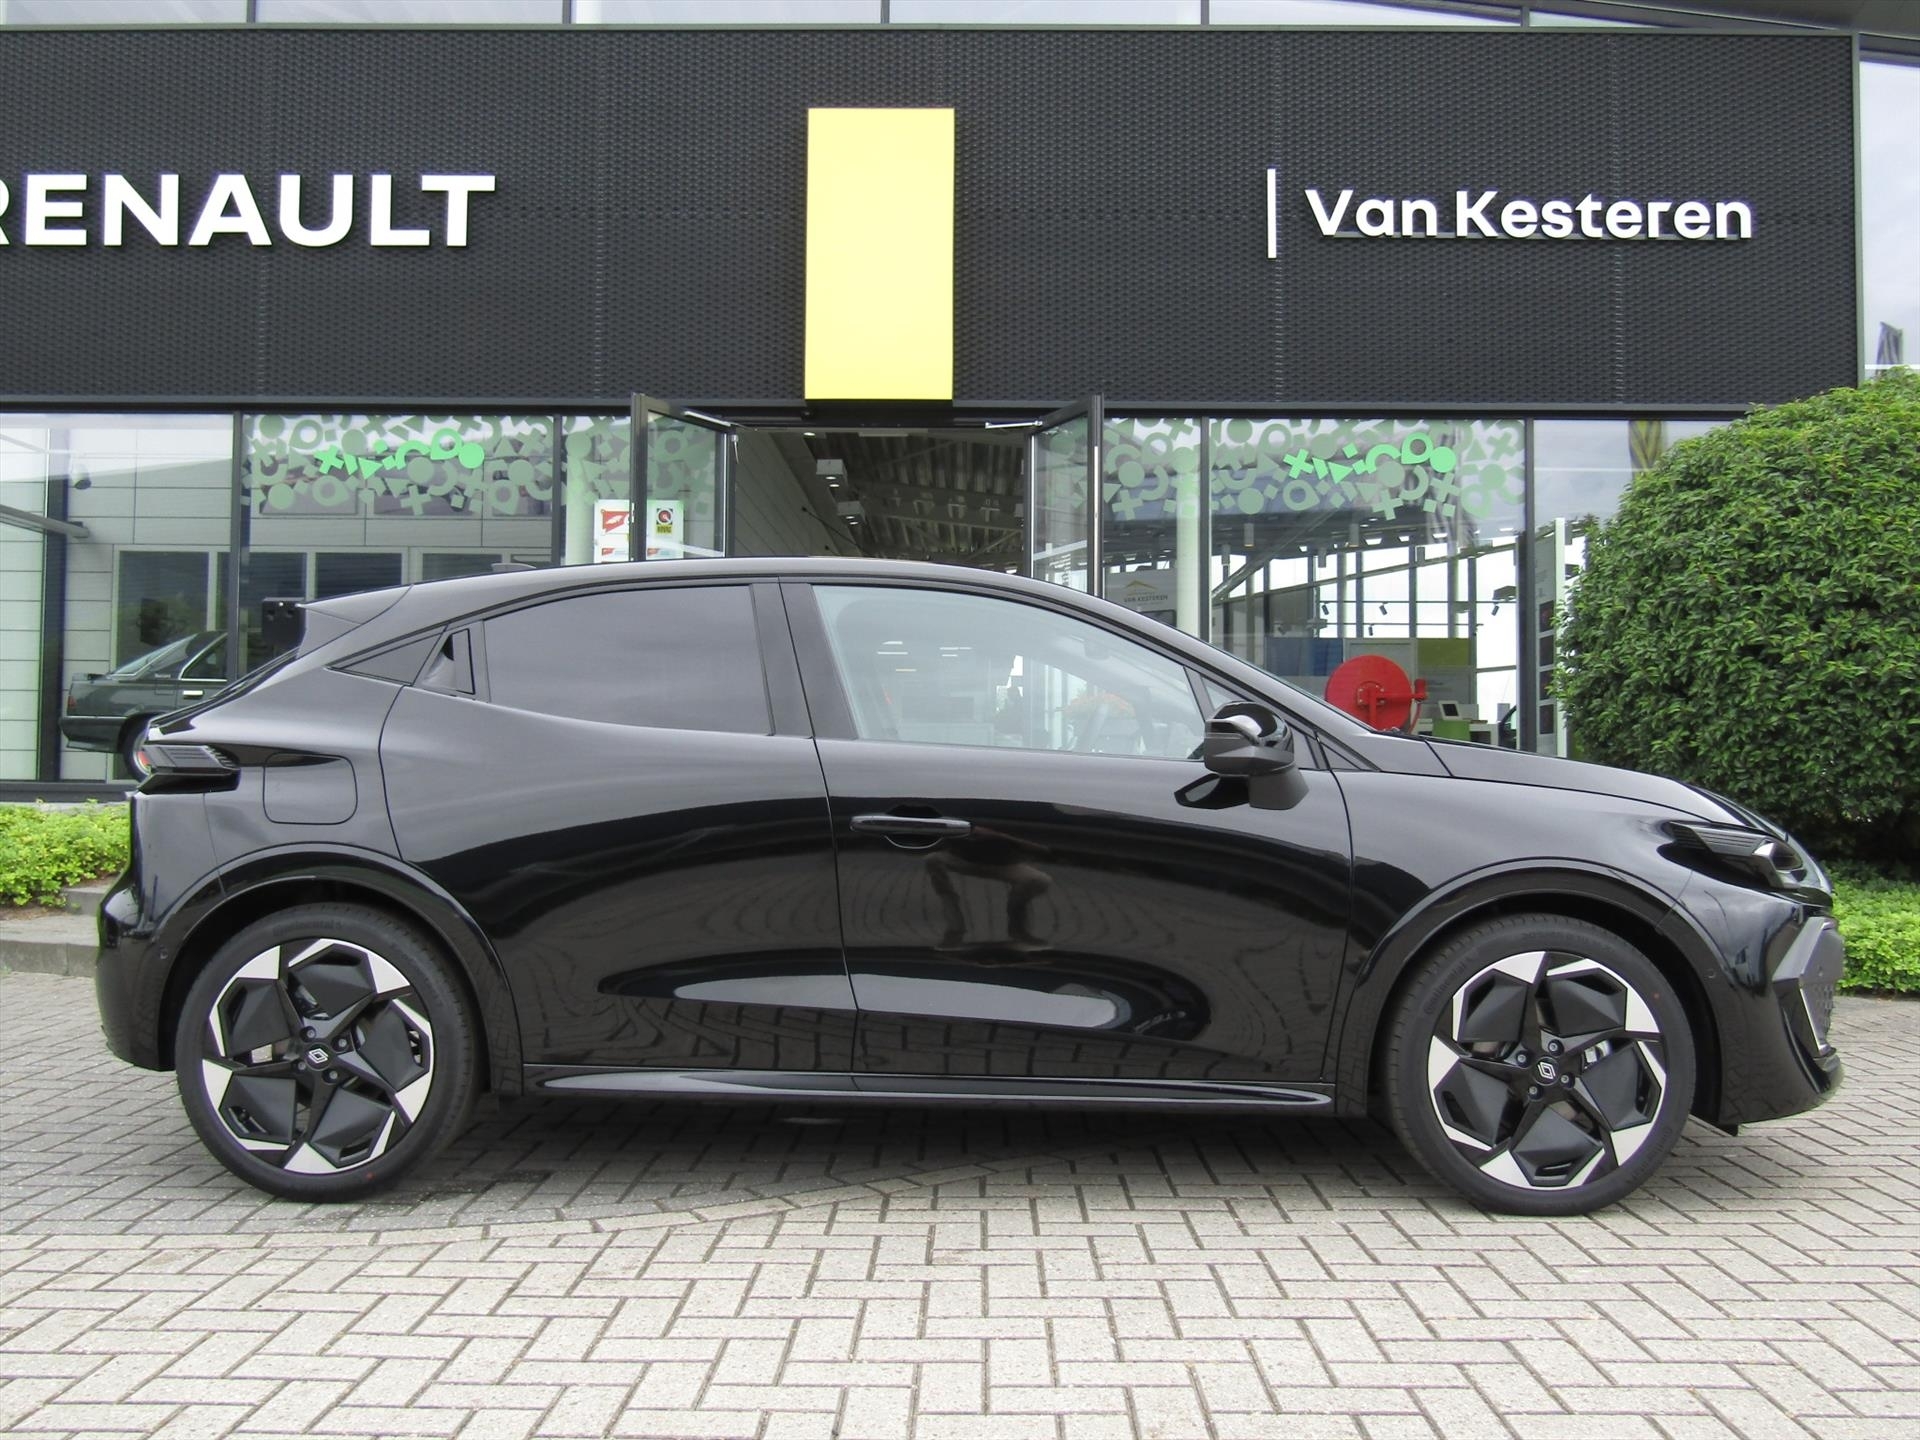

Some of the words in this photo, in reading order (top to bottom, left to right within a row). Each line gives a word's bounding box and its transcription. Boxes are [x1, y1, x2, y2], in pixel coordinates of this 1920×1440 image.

[0, 174, 496, 247] ENAULT
[1304, 189, 1438, 239] Van
[1456, 190, 1753, 240] Kesteren
